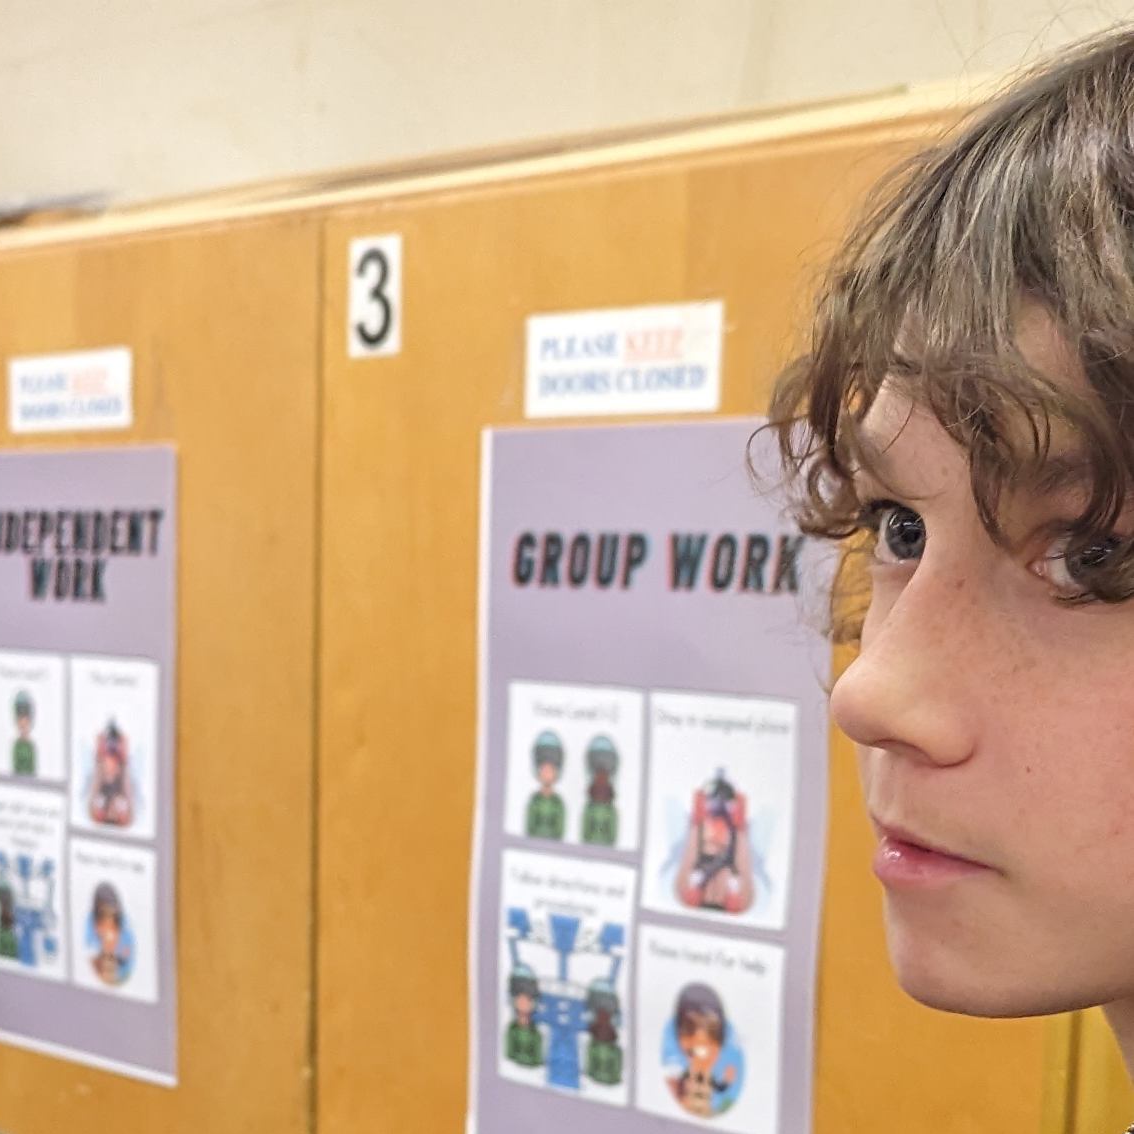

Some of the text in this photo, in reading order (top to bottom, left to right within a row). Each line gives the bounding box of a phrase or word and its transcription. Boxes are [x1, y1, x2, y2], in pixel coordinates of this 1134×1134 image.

[357, 246, 392, 348] 3
[540, 331, 618, 361] PLEASE
[616, 364, 709, 394] CLOSED
[30, 557, 106, 602] WORK
[514, 531, 802, 593] GROUP WORK
